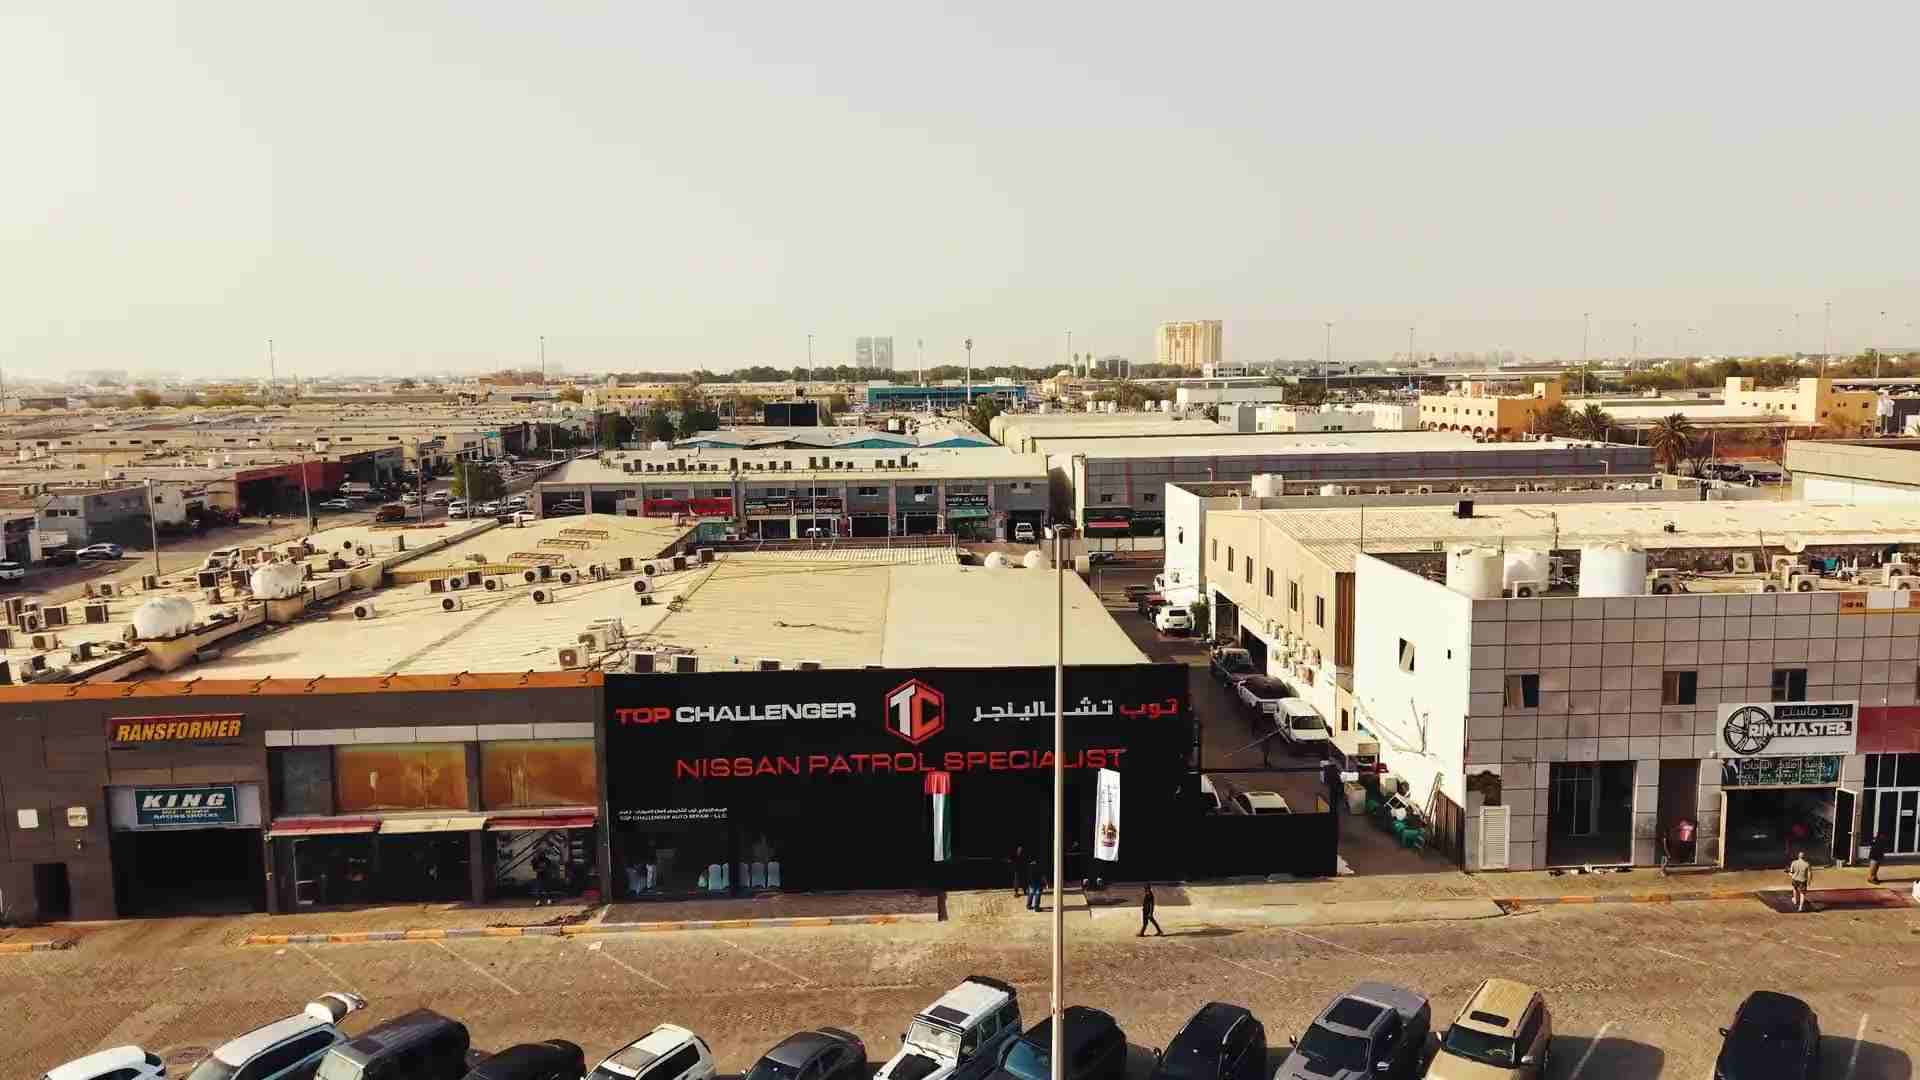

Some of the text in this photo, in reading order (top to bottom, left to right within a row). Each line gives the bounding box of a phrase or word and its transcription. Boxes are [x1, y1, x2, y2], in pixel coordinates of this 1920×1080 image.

[615, 702, 857, 724] TOP CHALLENGER
[1119, 698, 1179, 718] توب
[116, 720, 241, 742] RANSFORMER
[1749, 721, 1851, 737] RIM MASTER
[676, 748, 1127, 780] NISSAN PATROL SPECIALIST
[142, 793, 226, 808] KING
